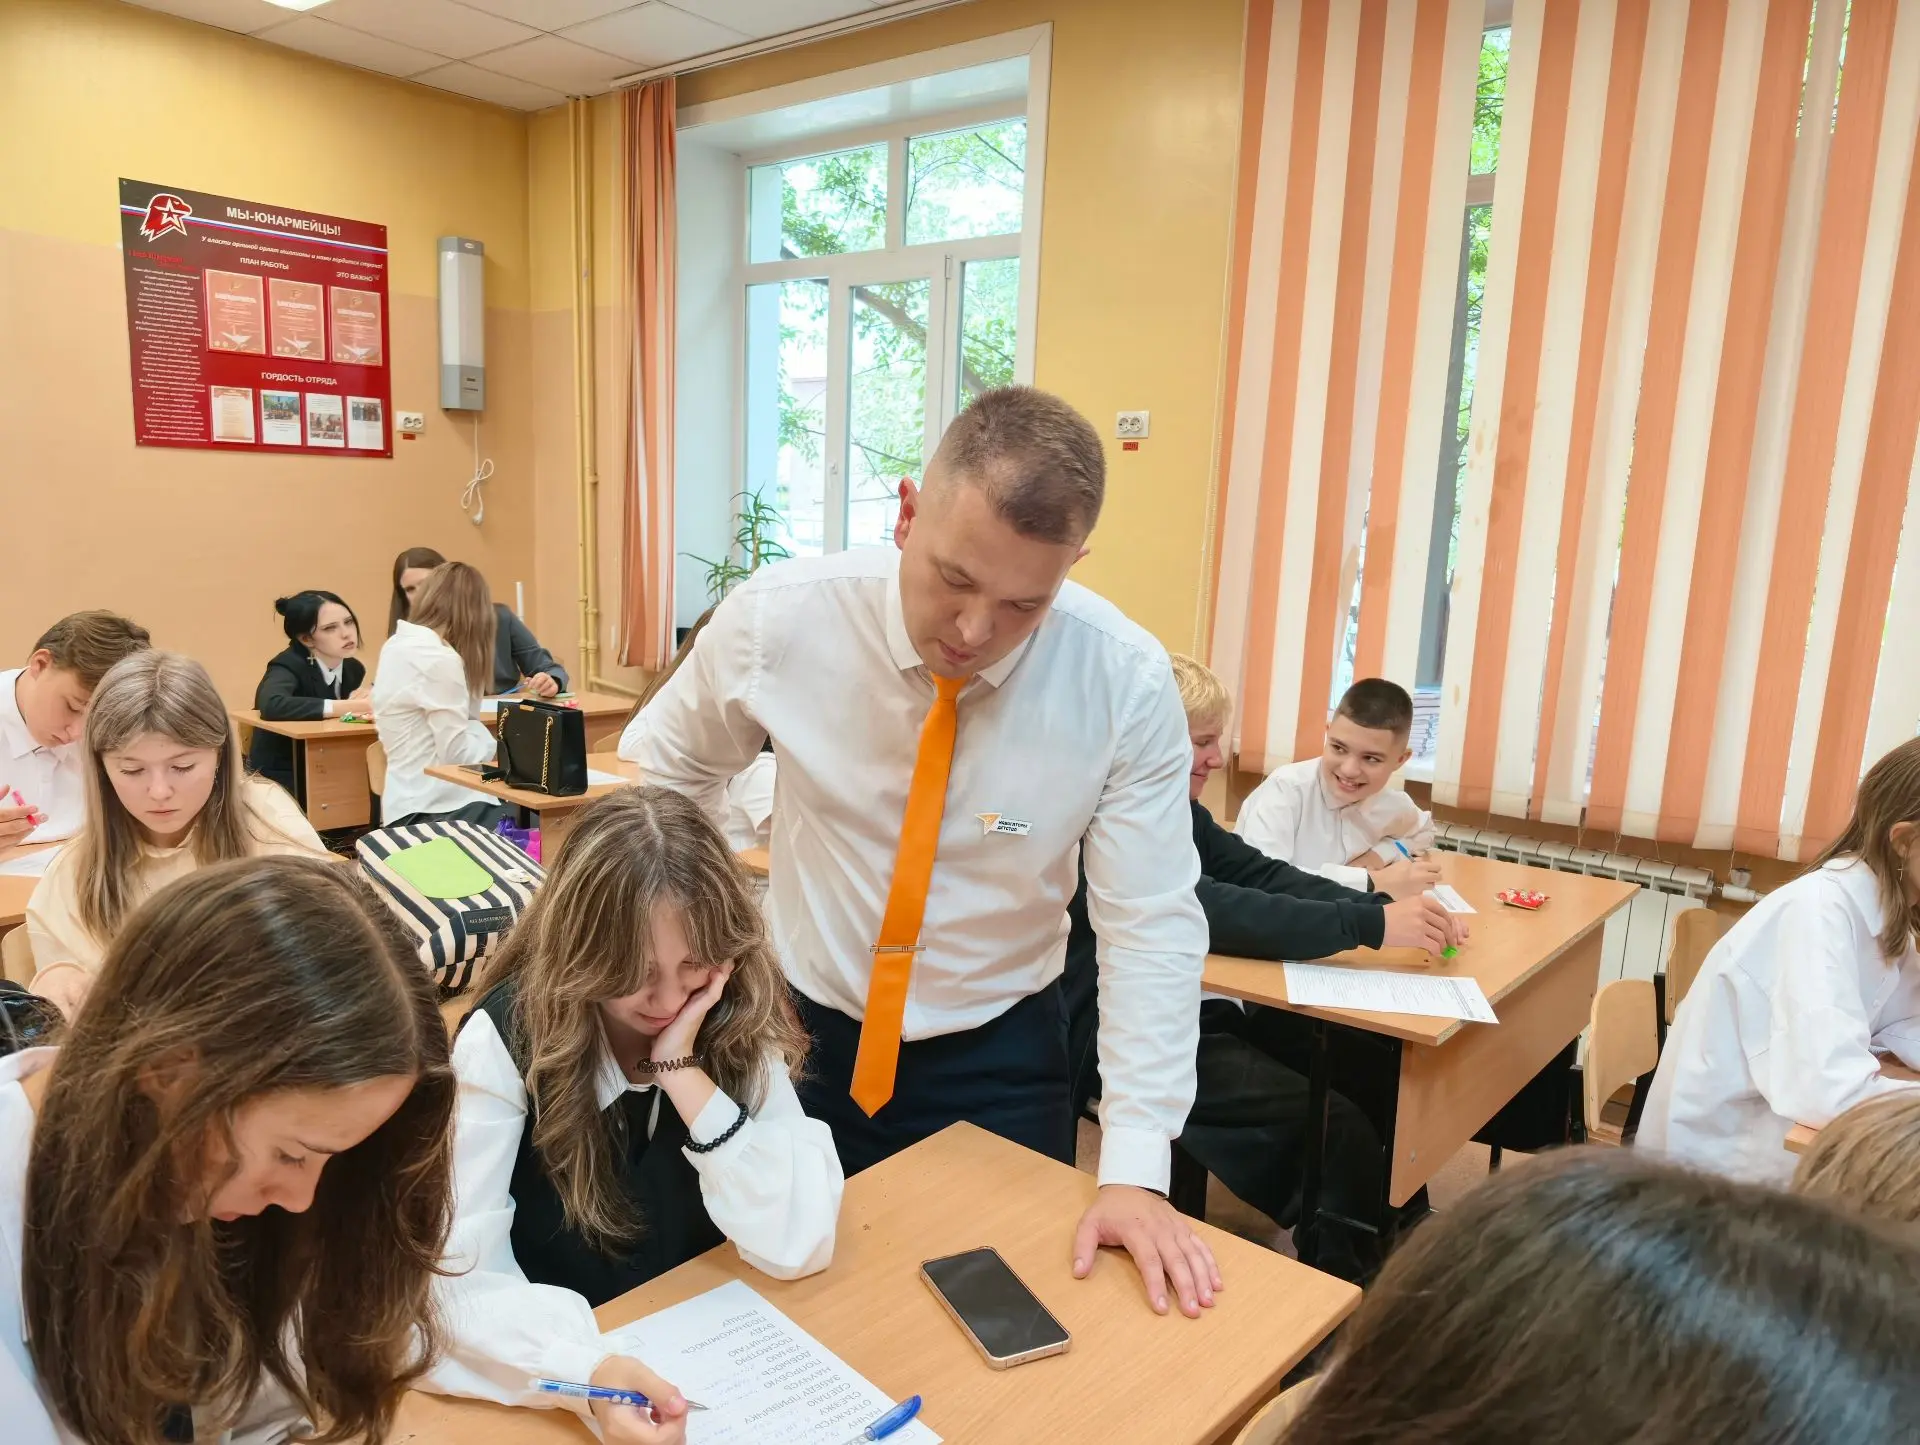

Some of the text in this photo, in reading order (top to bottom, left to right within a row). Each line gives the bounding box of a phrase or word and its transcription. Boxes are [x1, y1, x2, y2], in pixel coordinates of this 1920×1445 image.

[226, 206, 341, 236] МЫ-ЮНАРМЕЙЦЫ!
[240, 257, 289, 270] ПЛАН РАБОТЫ
[336, 271, 349, 279] ЭТО
[261, 372, 337, 385] ГОРДОСТЬ ОТРЯДА
[681, 1316, 767, 1354] ПОЗНАКОМЛЮСЬ
[750, 1323, 775, 1336] БУДУ
[728, 1330, 784, 1357] ПРОЧИТАЮ
[735, 1337, 793, 1366] ПОСМОТРЮ
[766, 1344, 800, 1363] УЗНАЮ
[761, 1350, 811, 1376] ДОБЬЮСЬ
[764, 1359, 821, 1388] ПОПРОБУЮ
[783, 1367, 831, 1392] НАУЧУСЬ
[802, 1375, 840, 1396] ЗАВЕДУ
[807, 1382, 850, 1407] СДЕЛАЮ
[819, 1392, 861, 1416] СЪЕЗЖУ
[744, 1393, 800, 1424] ПРИВЫЧКУ
[815, 1399, 871, 1430] ОТКАЖУСЬ
[848, 1408, 882, 1429] НАЧНУ
